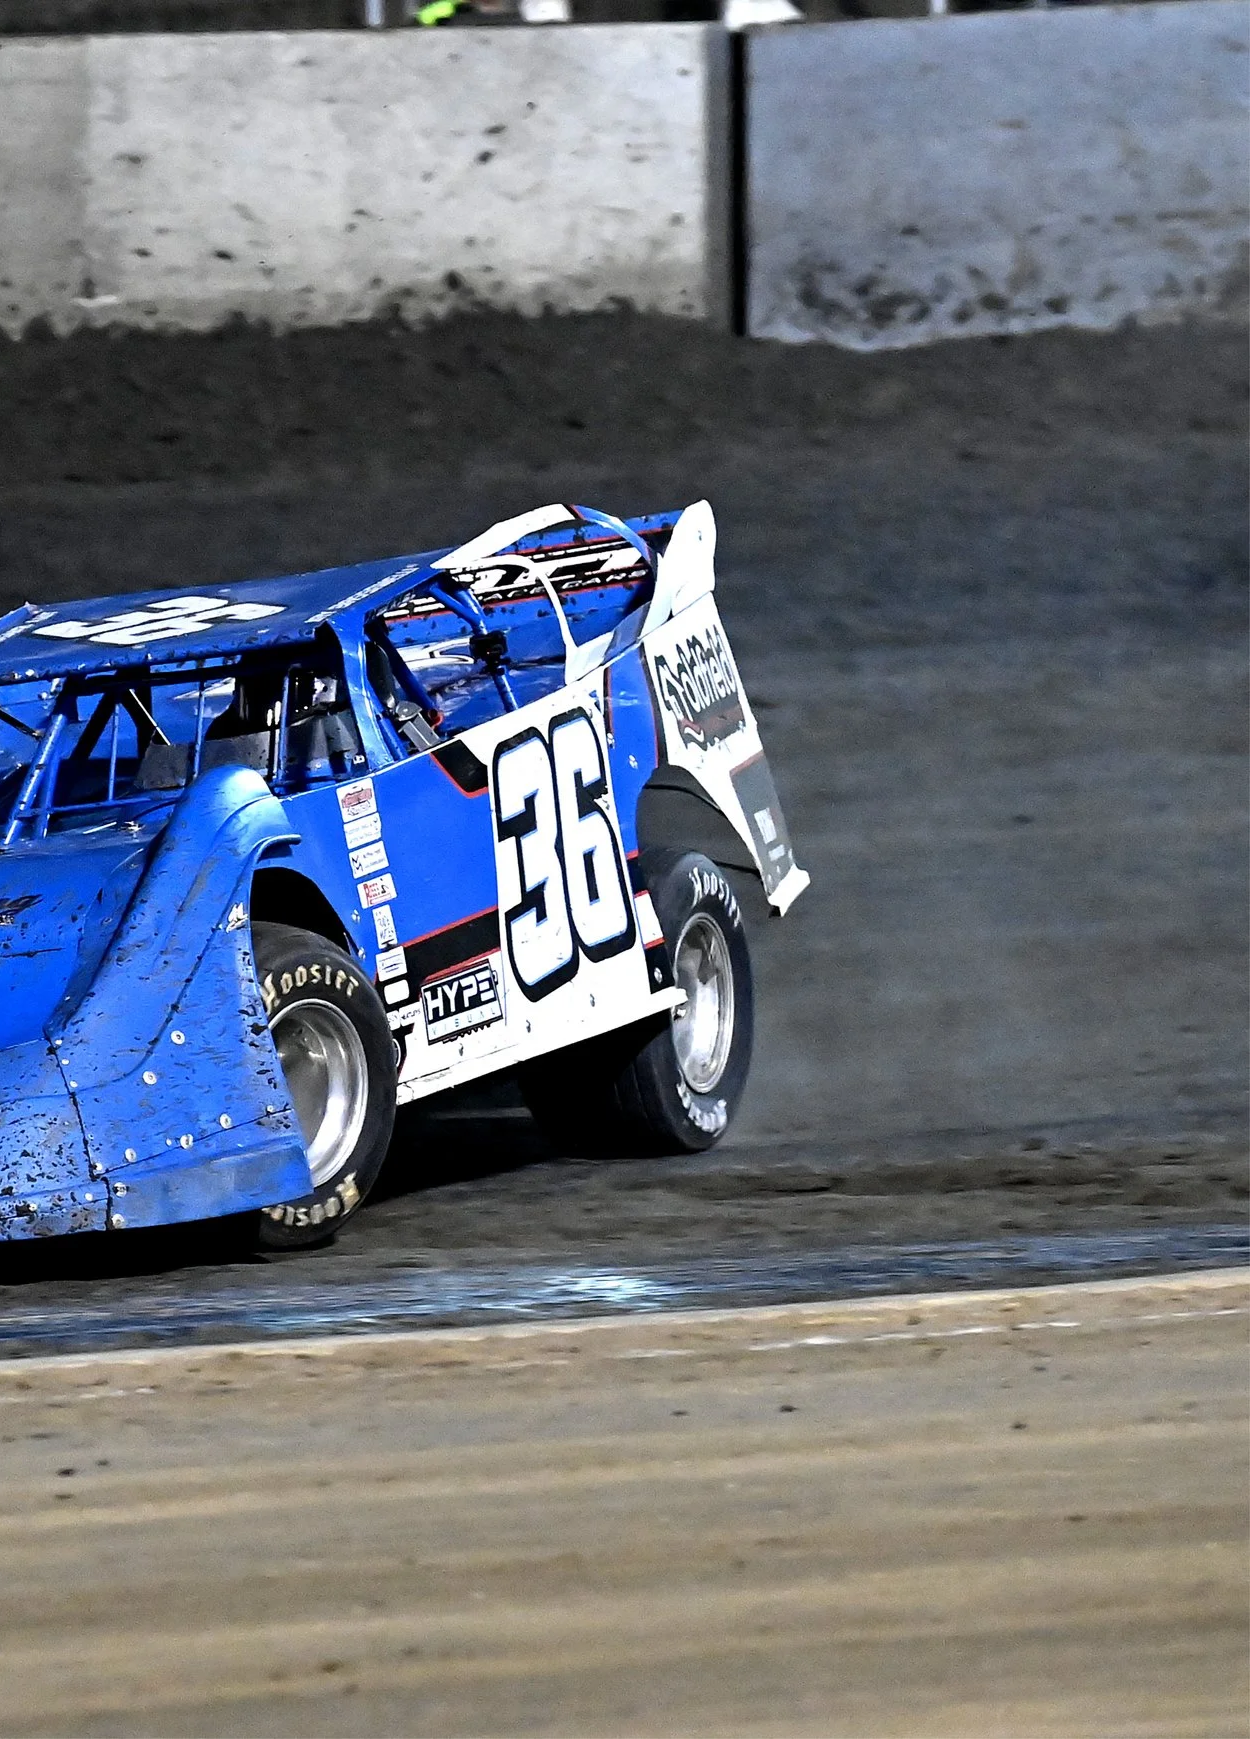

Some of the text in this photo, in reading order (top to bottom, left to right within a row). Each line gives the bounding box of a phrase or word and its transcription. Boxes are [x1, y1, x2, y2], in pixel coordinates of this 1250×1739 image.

[31, 595, 288, 647] 36
[492, 706, 637, 1003] 36
[424, 968, 496, 1021] HYPE
[431, 1006, 497, 1037] VISUAL
